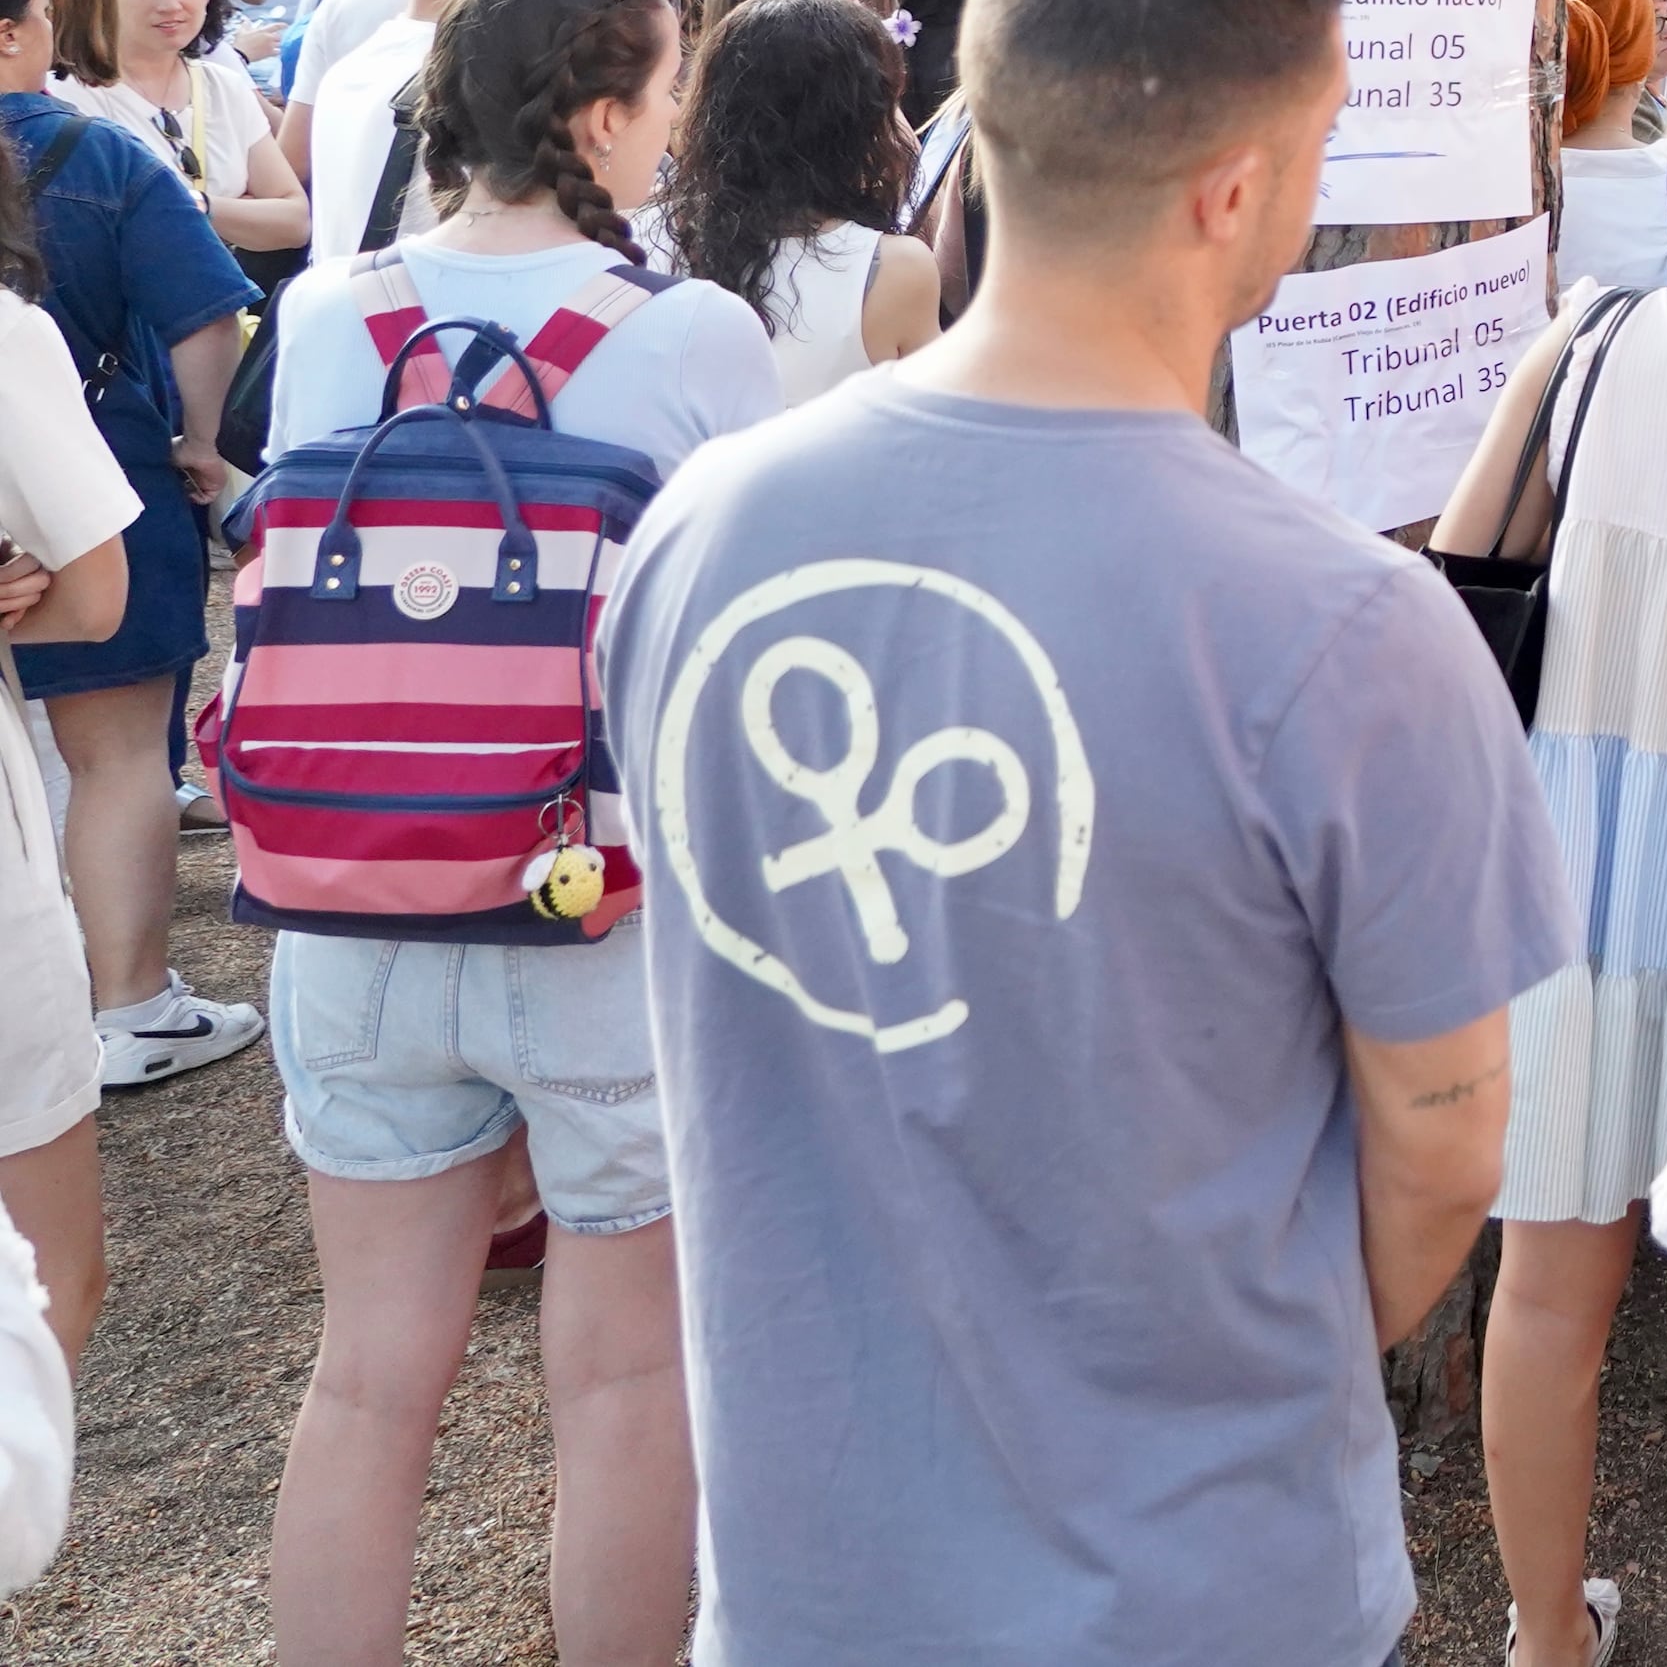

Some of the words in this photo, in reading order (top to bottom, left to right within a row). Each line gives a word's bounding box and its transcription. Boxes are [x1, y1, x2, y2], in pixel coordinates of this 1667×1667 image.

[1347, 33, 1413, 60] unal
[1431, 34, 1466, 60] 05
[1345, 81, 1411, 108] unal
[1429, 81, 1463, 108] 35
[1258, 311, 1342, 334] Puerta
[1348, 300, 1378, 322] 02
[1386, 282, 1468, 323] (Edificio
[1474, 259, 1531, 297] nuevo)
[1341, 327, 1460, 375] Tribunal
[1474, 317, 1505, 348] 05
[1343, 373, 1464, 423] Tribunal
[1477, 361, 1508, 393] 35
